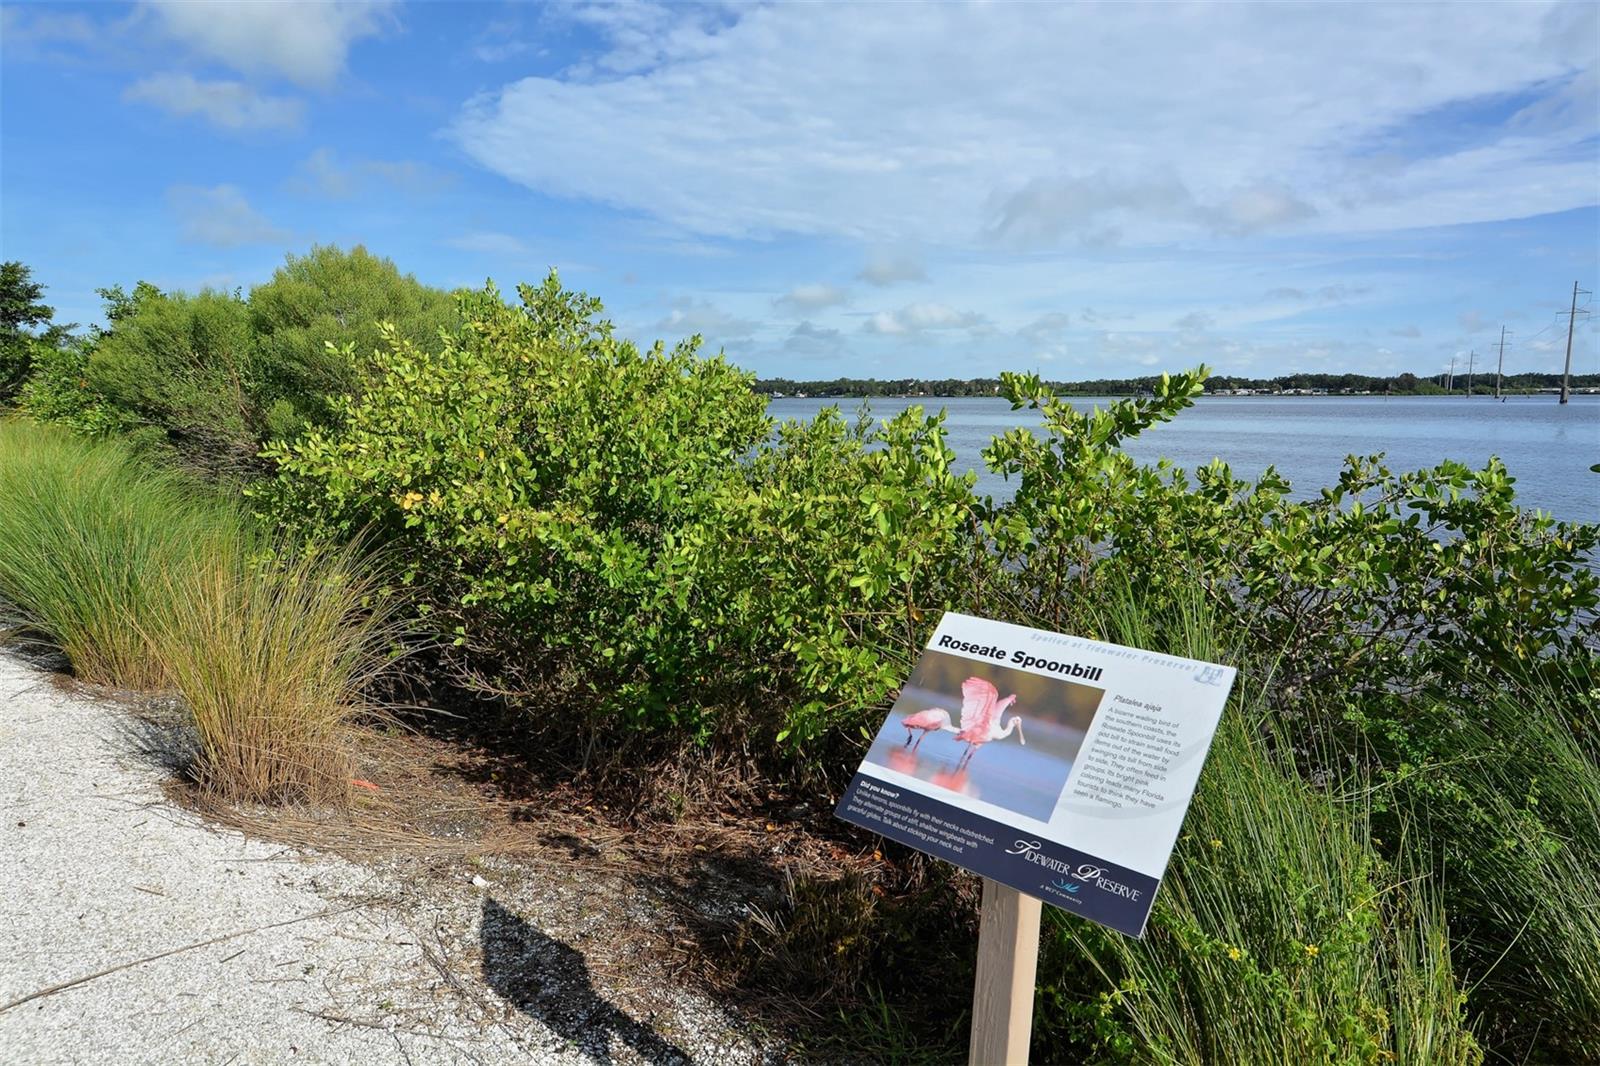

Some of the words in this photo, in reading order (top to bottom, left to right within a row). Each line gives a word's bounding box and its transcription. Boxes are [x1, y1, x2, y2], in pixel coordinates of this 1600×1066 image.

[939, 635, 1006, 659] Roseate
[1011, 651, 1103, 681] Spoonbill
[1087, 643, 1138, 659] Tidewater
[1114, 695, 1142, 707] Platalea
[1144, 703, 1162, 712] ajaja
[1114, 708, 1134, 718] bizarre
[1136, 714, 1157, 724] wading
[1159, 719, 1171, 728] bird
[1116, 718, 1142, 728] southern
[1143, 725, 1164, 734] coasts,
[1102, 722, 1126, 733] Roseate
[1127, 729, 1156, 740] Spoonbill
[1098, 731, 1109, 739] odd
[1128, 738, 1146, 747] strain
[1147, 743, 1163, 752] small
[1164, 748, 1179, 756] food
[1091, 747, 1117, 759] swinging
[1138, 759, 1152, 768] from
[1153, 764, 1168, 772] side
[1143, 752, 1161, 761] water
[1161, 756, 1170, 764] by
[1111, 761, 1125, 770] They
[1126, 766, 1143, 775] often
[1144, 771, 1159, 779] feed
[1116, 771, 1135, 783] bright
[1135, 778, 1148, 786] pink
[860, 780, 871, 788] Did
[869, 785, 880, 793] you
[881, 788, 899, 799] know?
[1077, 780, 1099, 791] tourists
[1108, 789, 1123, 798] think
[1125, 794, 1138, 804] they
[1140, 799, 1156, 808] have
[1080, 772, 1105, 784] coloring
[1105, 779, 1122, 788] leads
[1123, 785, 1140, 794] many
[1142, 789, 1164, 801] Florida
[847, 804, 868, 815] graceful
[892, 820, 907, 831] about
[907, 827, 927, 840] sticking
[926, 834, 939, 844] your
[938, 838, 952, 849] neck
[852, 795, 864, 805] They
[884, 809, 901, 820] groups
[919, 822, 938, 833] shallow
[939, 828, 966, 845] wingbeats
[966, 838, 978, 848] with
[912, 809, 920, 817] fly
[919, 812, 930, 820] with
[931, 816, 943, 825] their
[944, 821, 959, 831] necks
[1005, 840, 1070, 875] TIDEWATER
[1071, 864, 1140, 902] PRESERVE
